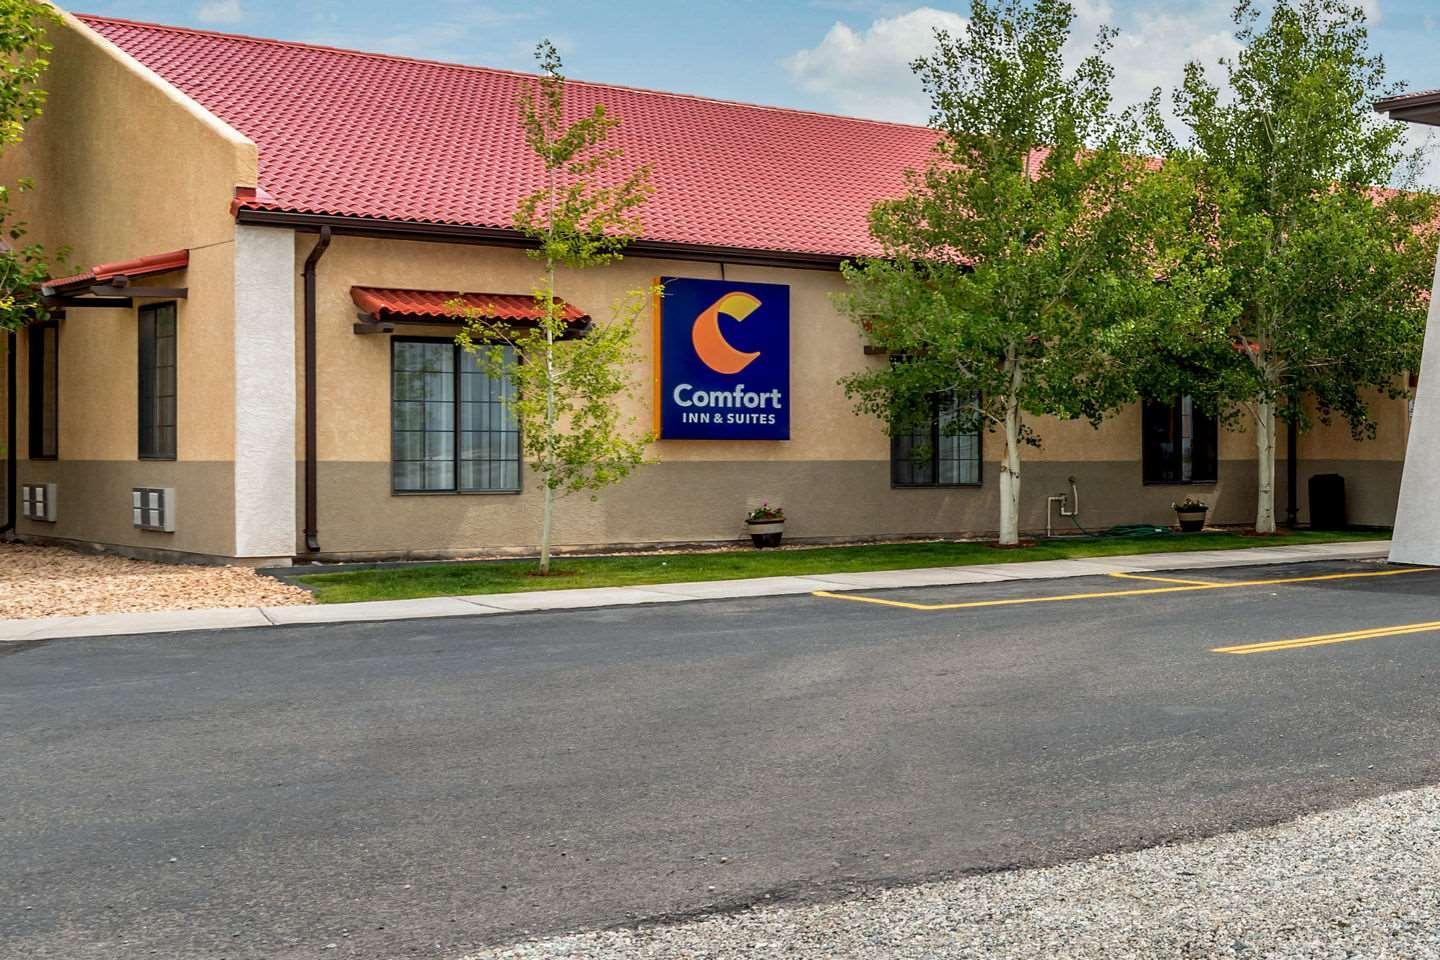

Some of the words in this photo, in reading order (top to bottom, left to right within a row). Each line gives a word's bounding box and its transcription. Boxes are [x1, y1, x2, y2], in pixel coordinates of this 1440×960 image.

[673, 383, 782, 409] Comfort
[682, 412, 710, 424] INN
[713, 413, 724, 424] &
[727, 413, 776, 425] SUITES
